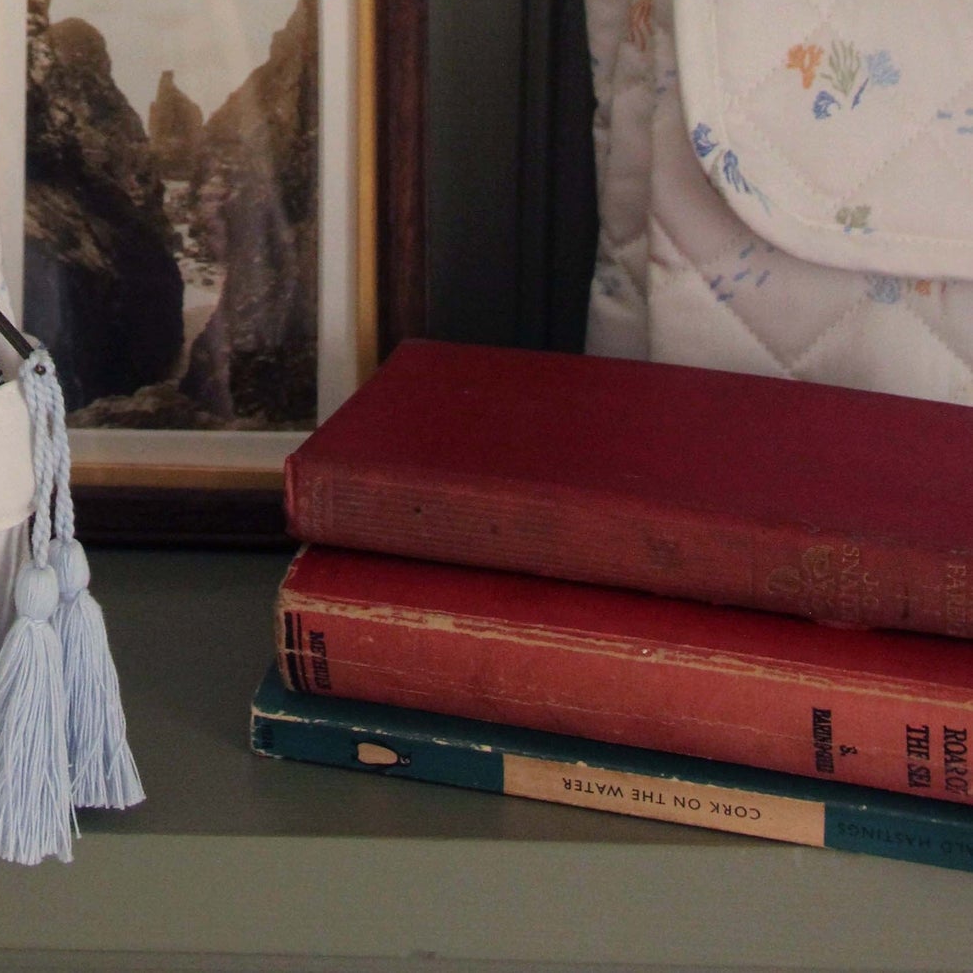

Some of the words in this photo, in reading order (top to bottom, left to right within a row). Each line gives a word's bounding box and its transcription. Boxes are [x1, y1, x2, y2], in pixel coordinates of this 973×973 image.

[906, 724, 930, 761] THE
[943, 725, 968, 776] ROAR
[907, 763, 931, 788] SEA
[562, 777, 624, 798] WATER
[632, 788, 666, 805] THE
[674, 795, 701, 811] ON
[710, 800, 761, 820] CORK
[837, 822, 931, 848] HASTINGS
